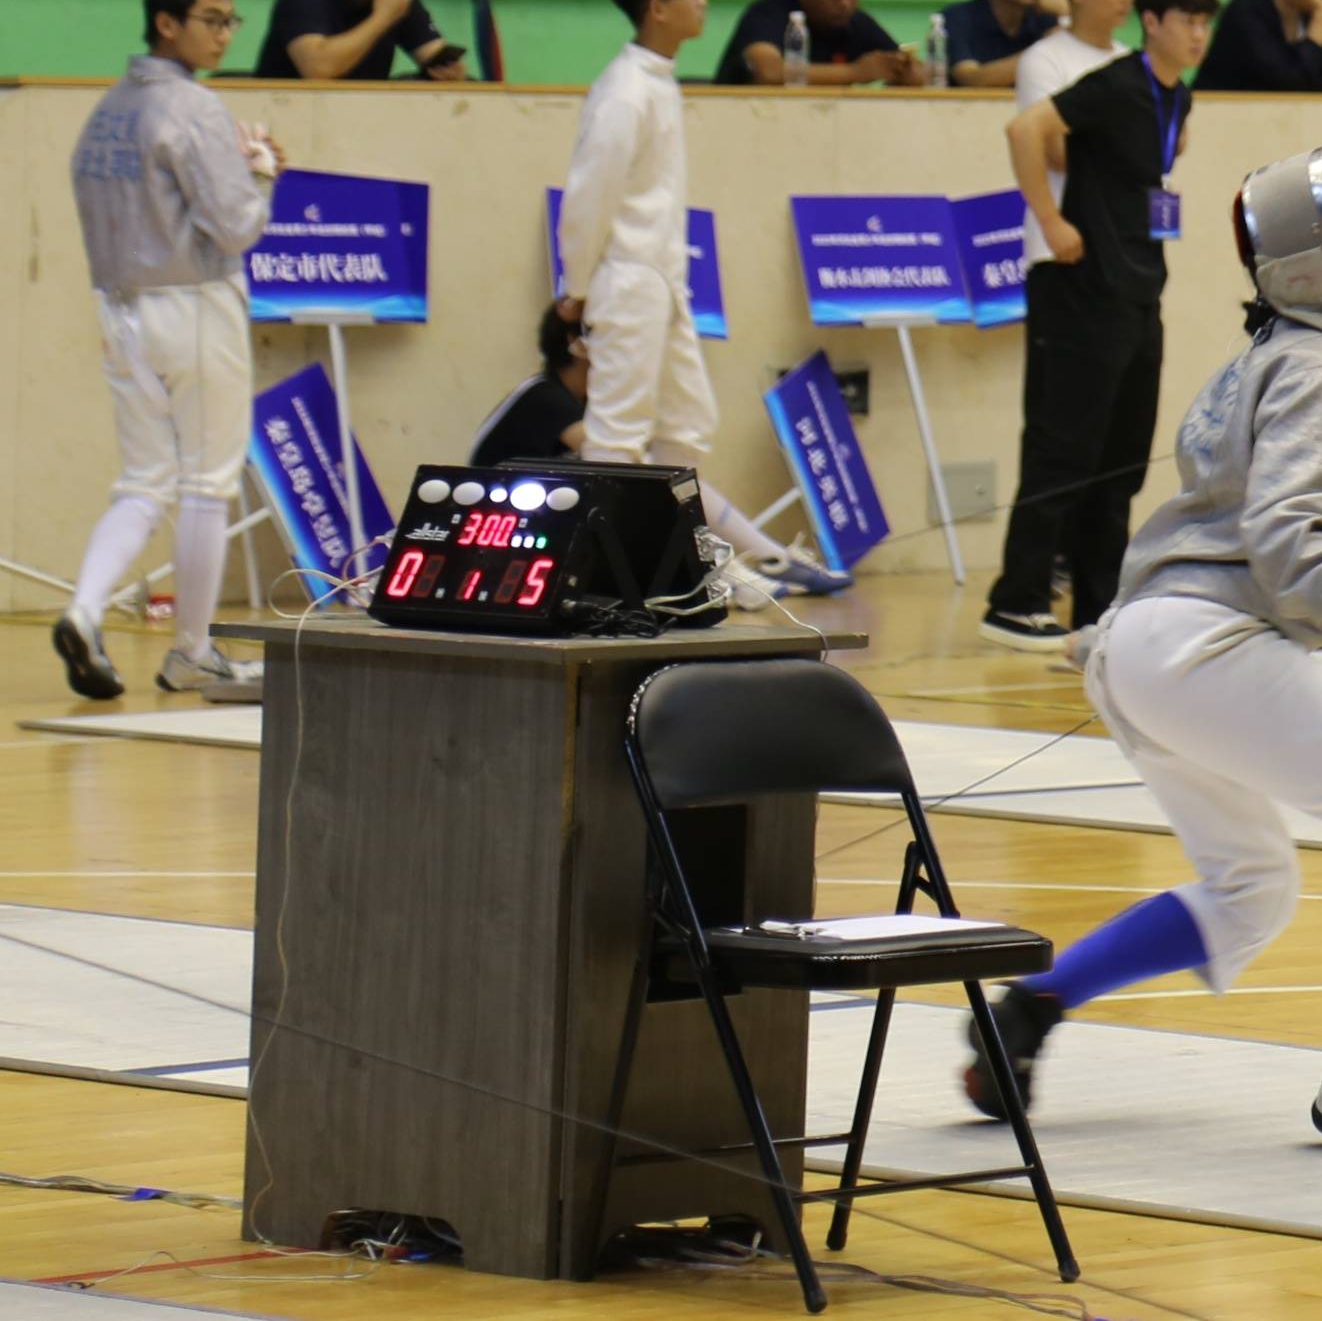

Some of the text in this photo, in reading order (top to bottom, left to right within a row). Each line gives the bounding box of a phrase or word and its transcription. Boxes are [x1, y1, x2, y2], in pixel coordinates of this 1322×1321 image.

[251, 252, 388, 282] 保定市代表队
[387, 551, 553, 606] 0 1 5
